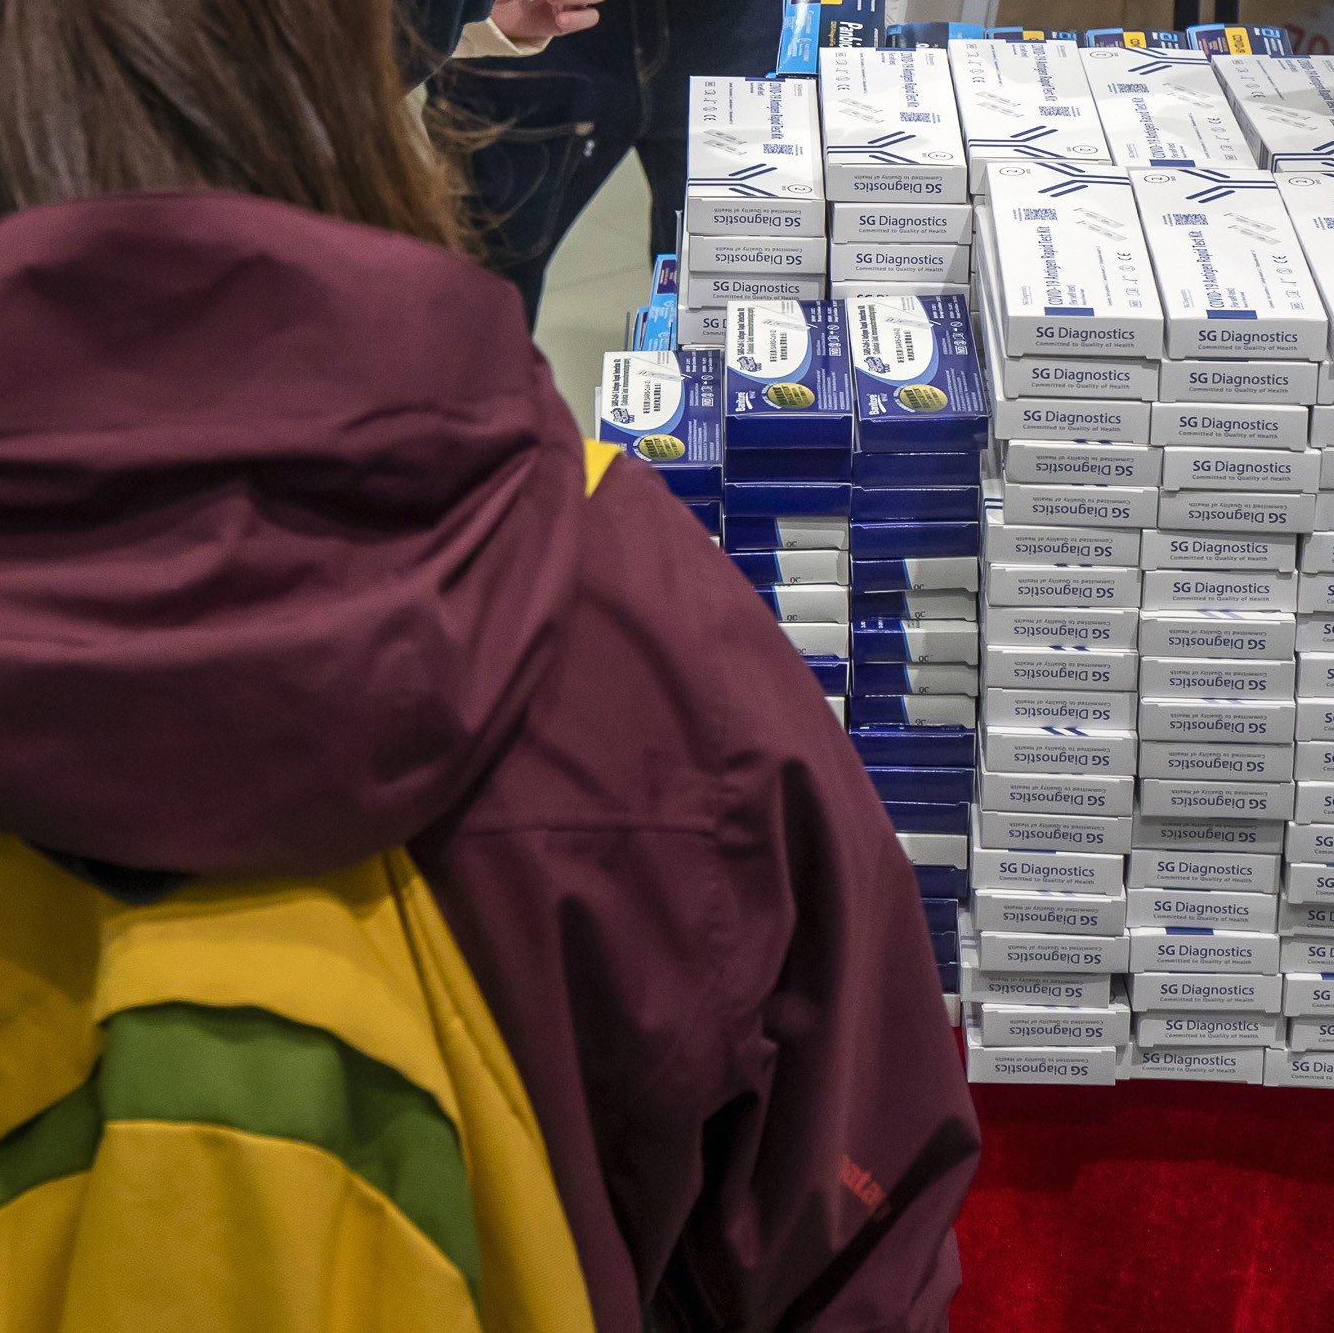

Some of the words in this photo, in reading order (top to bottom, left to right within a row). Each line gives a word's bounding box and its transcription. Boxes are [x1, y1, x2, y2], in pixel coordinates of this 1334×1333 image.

[840, 20, 863, 48] Panbi
[854, 180, 923, 194] Diagnostics
[925, 183, 943, 194] SG
[713, 213, 781, 227] Diagnostics
[784, 216, 801, 228] SG
[859, 215, 876, 226] SG
[879, 215, 947, 229] Diagnostics
[1039, 234, 1052, 244] Test
[1191, 239, 1206, 248] Test
[715, 251, 783, 265] Diagnostics
[1040, 245, 1058, 259] Rapid
[1193, 249, 1213, 262] Rapid
[785, 255, 803, 266] SG
[855, 253, 873, 264] SG
[875, 253, 944, 267] Diagnostics
[1043, 260, 1061, 280] Antigen
[1201, 264, 1218, 283] Antigen
[713, 280, 730, 292] SG
[732, 281, 800, 295] Diagnostics
[1046, 280, 1063, 305] COVID-19
[1205, 284, 1225, 308] COVID-19
[1036, 326, 1055, 338] SG
[1058, 326, 1135, 342] Diagnostics
[1198, 330, 1217, 342] SG
[1221, 330, 1298, 345] Diagnostics
[1032, 368, 1051, 380] SG
[1054, 368, 1130, 383] Diagnostics
[1189, 372, 1208, 384] SG
[1212, 372, 1289, 388] Diagnostics
[1023, 410, 1042, 422] SG
[1045, 410, 1121, 426] Diagnostics
[1179, 416, 1197, 428] SG
[1201, 417, 1278, 432] Diagnostics
[1036, 461, 1111, 476] Diagnostics
[1115, 465, 1133, 476] SG
[1193, 460, 1211, 472] SG
[1215, 460, 1291, 476] Diagnostics
[1032, 503, 1108, 518] Diagnostics
[1111, 507, 1130, 519] SG
[1188, 508, 1265, 523] Diagnostics
[1268, 512, 1287, 524] SG
[1015, 542, 1091, 557] Diagnostics
[1094, 546, 1113, 557] SG
[1171, 540, 1189, 552] SG
[1192, 541, 1268, 556] Diagnostics
[1018, 584, 1093, 598] Diagnostics
[1096, 587, 1114, 598] SG
[1173, 582, 1191, 593] SG
[1195, 582, 1270, 596] Diagnostics
[1009, 828, 1083, 843] Diagnostics
[1086, 833, 1104, 844] SG
[1161, 828, 1234, 842] Diagnostics
[1239, 832, 1256, 843] SG
[1315, 835, 1333, 847] SG
[1154, 900, 1172, 912] SG
[1175, 901, 1249, 916] Diagnostics
[1003, 911, 1077, 926] Diagnostics
[1080, 915, 1098, 926] SG
[1308, 910, 1325, 921] SG
[989, 984, 1061, 997] Diagnostics
[1065, 987, 1083, 998] SG
[1160, 984, 1178, 995] SG
[1181, 984, 1255, 998] Diagnostics
[1313, 990, 1331, 1001] SG
[1142, 1053, 1161, 1064] SG
[1163, 1054, 1237, 1069] Diagnostics
[1292, 1060, 1310, 1072] SG
[995, 1062, 1067, 1076] Diagnostics
[1071, 1066, 1088, 1076] SG
